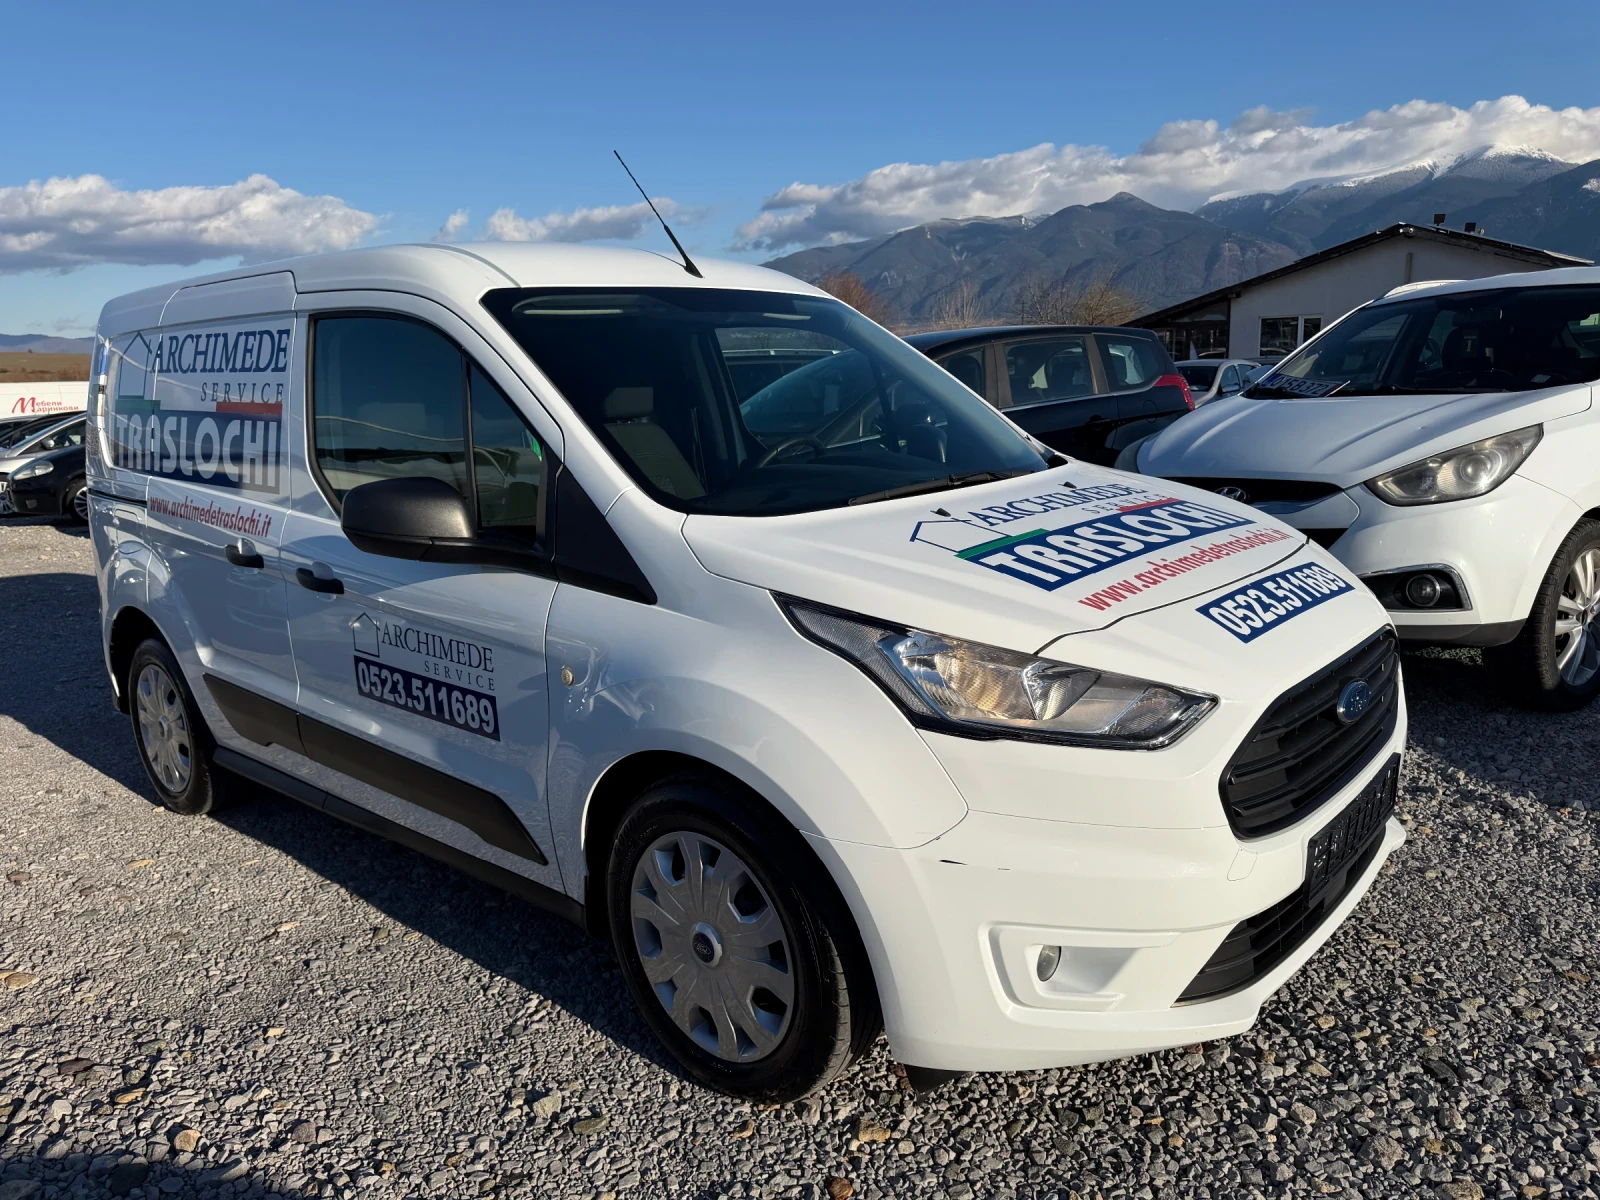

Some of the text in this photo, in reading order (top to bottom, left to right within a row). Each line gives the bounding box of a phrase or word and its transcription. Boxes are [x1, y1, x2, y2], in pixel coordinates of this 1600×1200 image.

[150, 329, 290, 374] ARCHIMEDE
[201, 382, 284, 403] SERVICE
[116, 413, 278, 487] TRASLOCHI
[150, 496, 272, 537] www.archimedetraslochi.it
[967, 483, 1147, 527] ARCHIMEDE
[1081, 494, 1172, 514] SERVICE
[978, 502, 1247, 583] TRASLOCHI
[1078, 527, 1293, 611] www.archimedetraslochi.it
[1208, 564, 1347, 636] 0523.511689
[381, 621, 494, 673] ARCHIMEDE
[357, 661, 495, 734] 0523.511689
[424, 660, 495, 691] SERVICE
